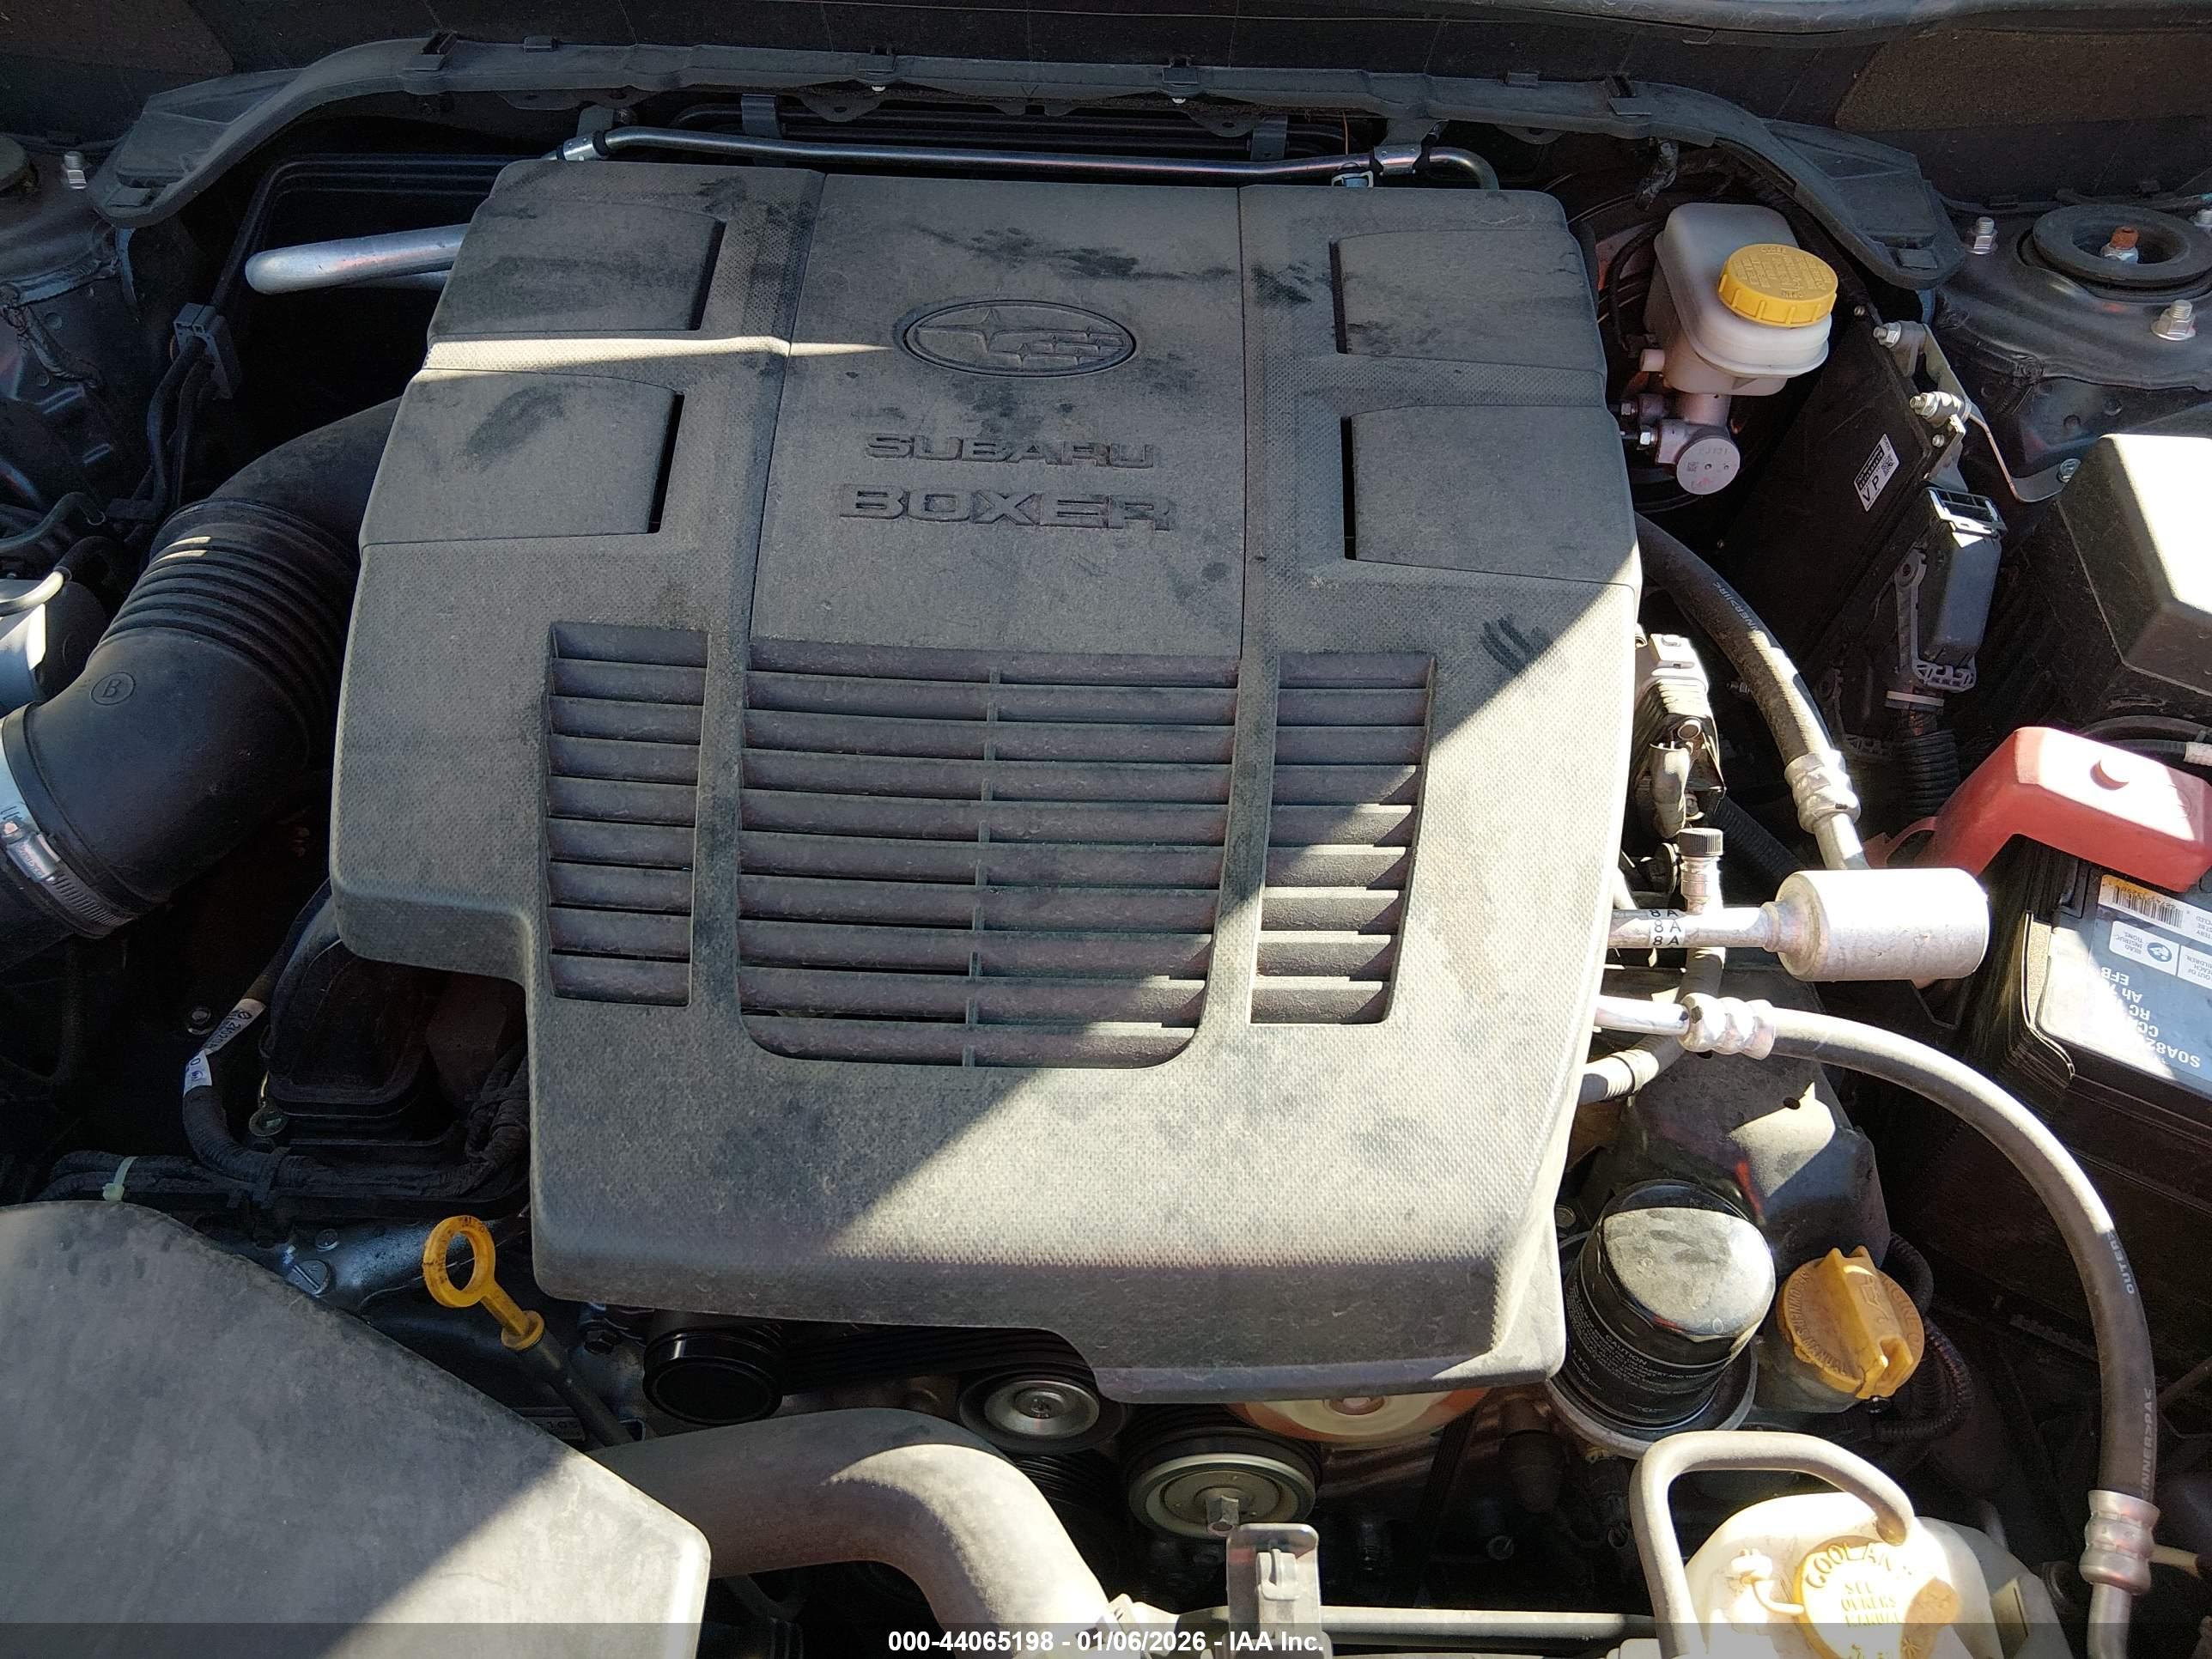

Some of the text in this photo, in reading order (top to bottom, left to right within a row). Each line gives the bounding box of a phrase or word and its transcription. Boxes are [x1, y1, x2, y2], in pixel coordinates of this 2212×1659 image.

[865, 433, 1154, 469] SUBARU
[839, 483, 1172, 531] BOXER
[2100, 966, 2130, 987] EFB
[2122, 988, 2143, 1004] Ah
[2130, 1004, 2151, 1021] RC
[1605, 1334, 1648, 1367] CAUTION
